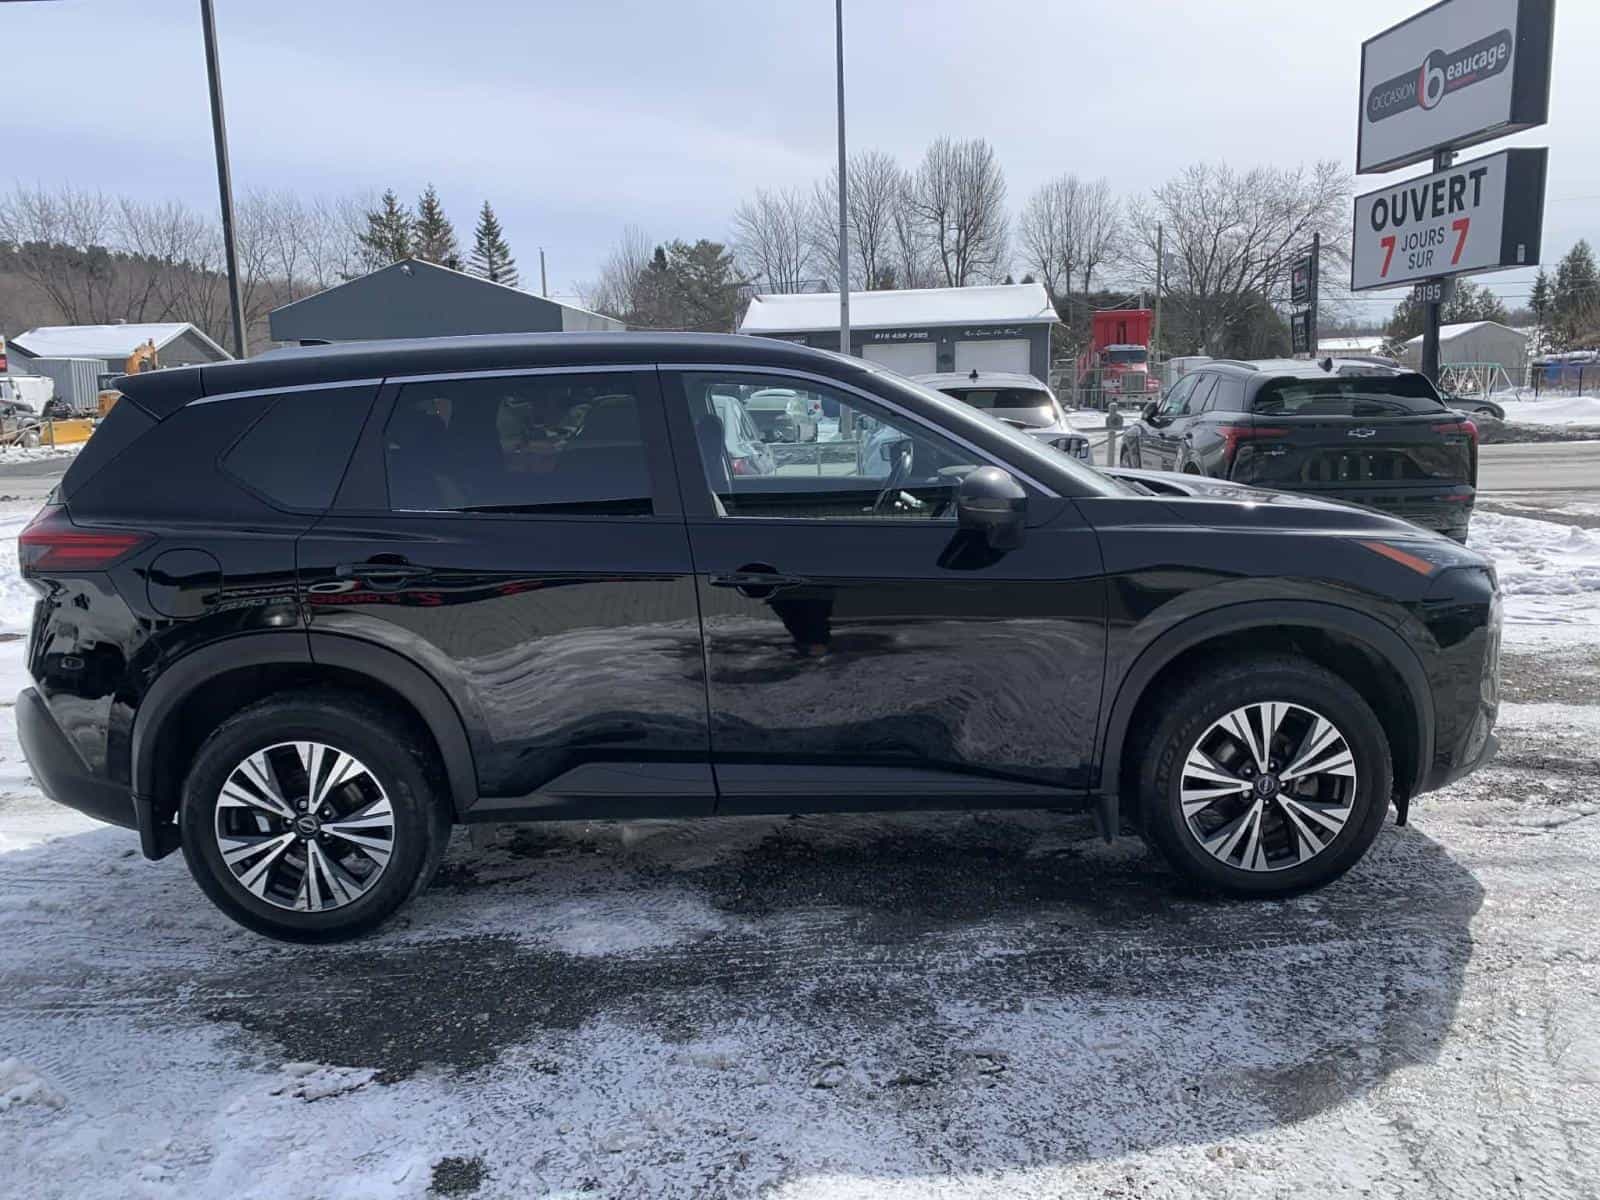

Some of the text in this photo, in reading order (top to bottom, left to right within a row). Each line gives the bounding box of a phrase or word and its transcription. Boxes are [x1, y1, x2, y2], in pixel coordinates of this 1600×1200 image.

[1372, 81, 1416, 111] OCCASION
[1371, 167, 1488, 232] OUVERT
[1380, 217, 1470, 278] 7 JOURS 7
[1408, 250, 1433, 270] SUR
